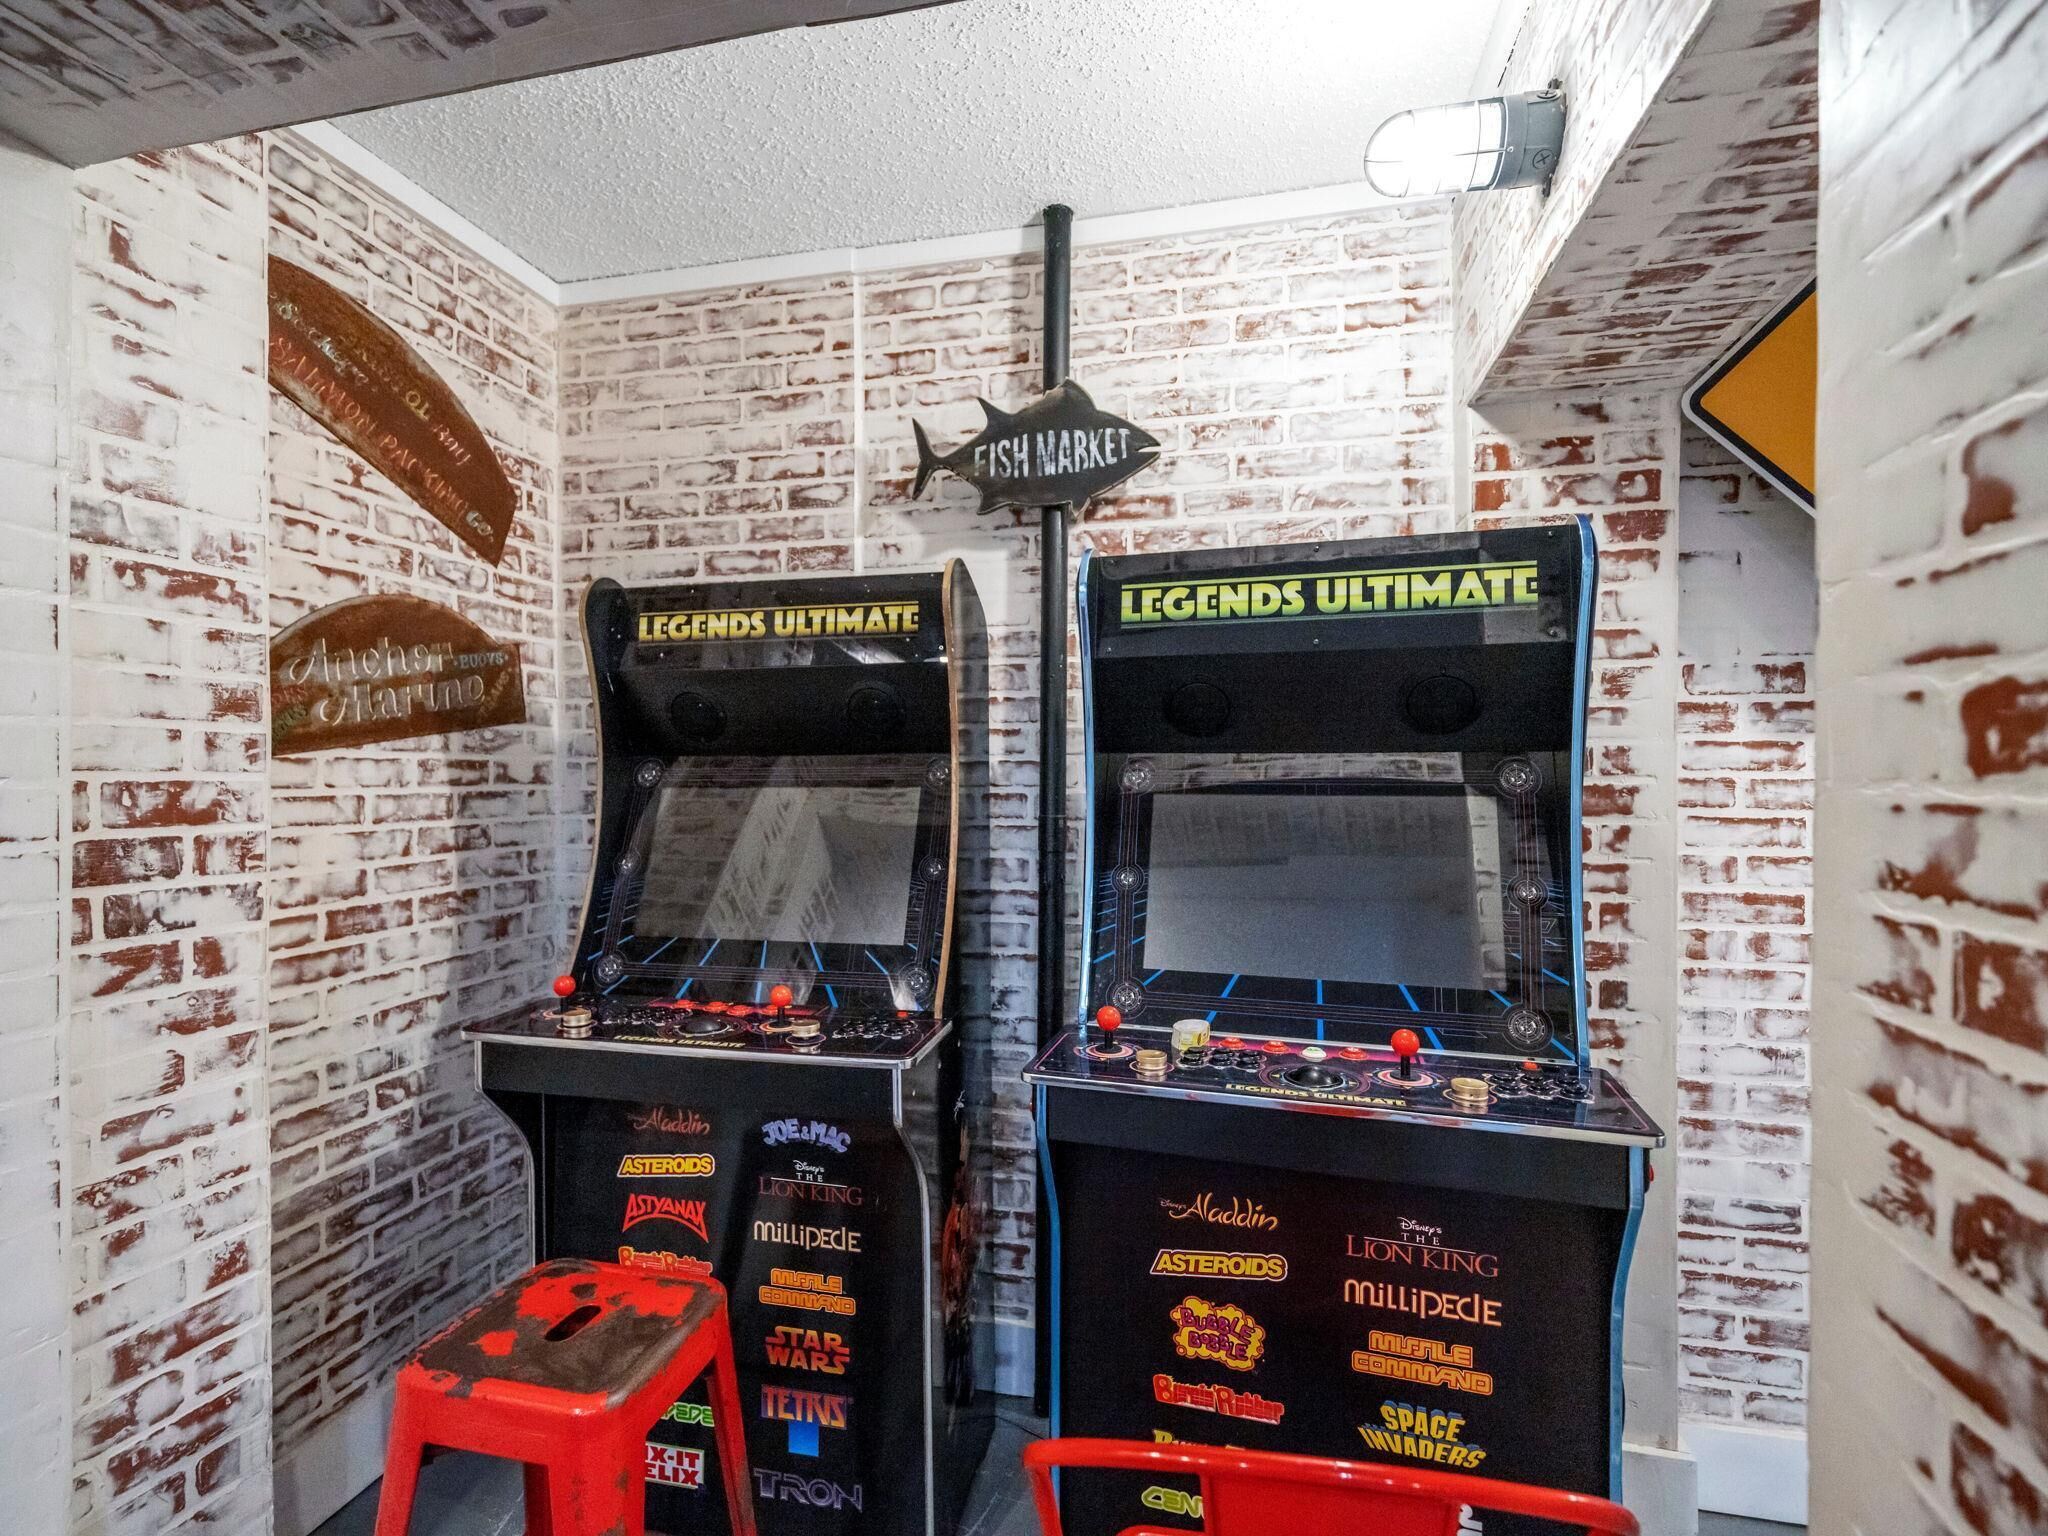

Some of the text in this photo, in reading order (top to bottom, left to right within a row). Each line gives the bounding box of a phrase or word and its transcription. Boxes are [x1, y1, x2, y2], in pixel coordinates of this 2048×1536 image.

[974, 428, 1131, 478] FISH MARKET
[380, 434, 469, 518] PACKING
[1121, 567, 1538, 622] LEGENDS ULTIMATE
[638, 605, 919, 642] LEGENDS ULTIMATE
[281, 637, 454, 684] Anchor
[614, 1035, 746, 1048] LEGENDS ULTIMATE
[1226, 1083, 1407, 1107] LEGENDS ULTIMATE
[633, 1106, 710, 1135] Aladdin
[621, 1157, 713, 1174] ASTEROIDS
[796, 1173, 823, 1182] THE
[760, 1177, 863, 1206] LION KING
[622, 1193, 709, 1243] ASTYANAX
[1168, 1192, 1279, 1230] Aladdin
[1401, 1232, 1440, 1246] THE
[1156, 1253, 1283, 1277] ASTEROIDS
[1346, 1235, 1499, 1278] LION KING
[759, 1286, 856, 1316] COMMAND
[765, 1326, 850, 1356] STAR
[1180, 1307, 1255, 1345] BUBBLE
[765, 1344, 850, 1375] WARS
[1187, 1330, 1249, 1361] BOBBLE
[1352, 1350, 1492, 1396] COMMAND
[763, 1386, 845, 1428] TETRIS
[1379, 1400, 1466, 1443] SPACE
[645, 1446, 700, 1468] X-IT
[1358, 1423, 1487, 1469] INVADERS
[645, 1462, 700, 1486] ELIX
[753, 1468, 863, 1513] TRON
